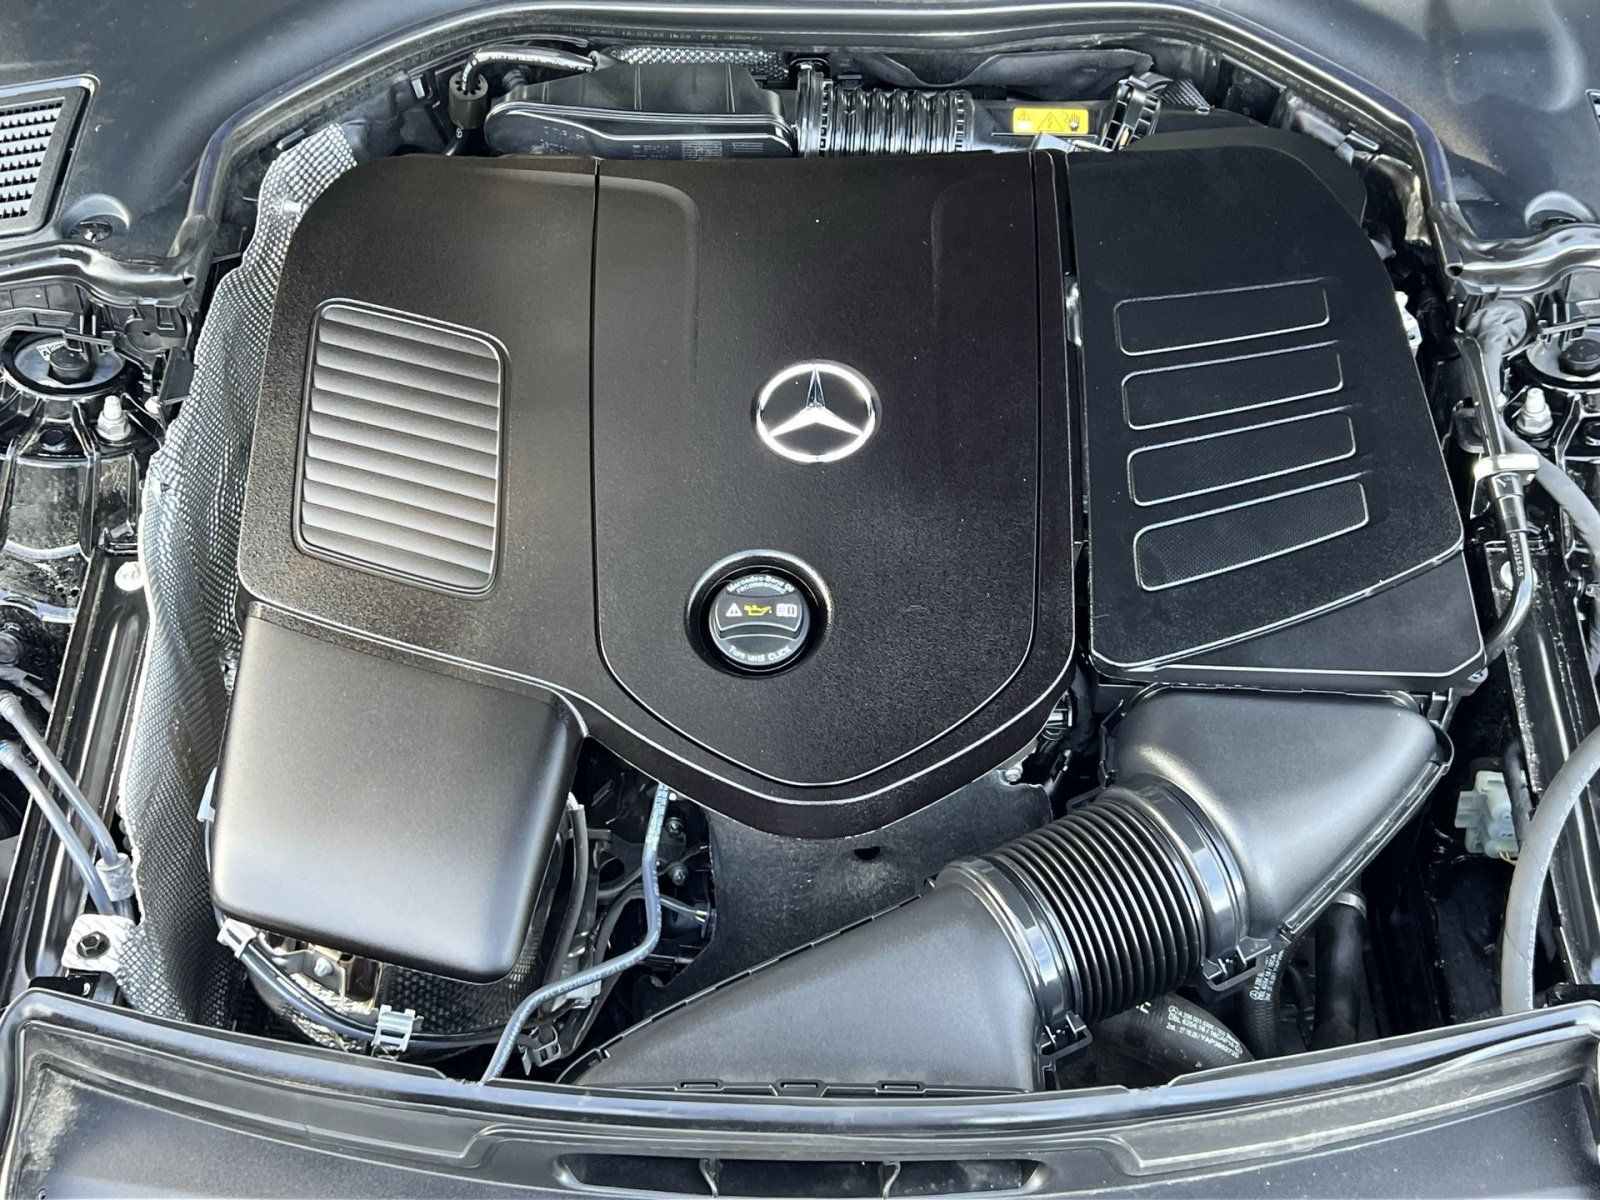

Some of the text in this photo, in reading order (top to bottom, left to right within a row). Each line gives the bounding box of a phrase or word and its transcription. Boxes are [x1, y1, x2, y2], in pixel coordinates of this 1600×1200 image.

[727, 575, 785, 592] Mercedes-Benz
[736, 581, 786, 594] recommended
[729, 645, 792, 662] Turn until CLICK
